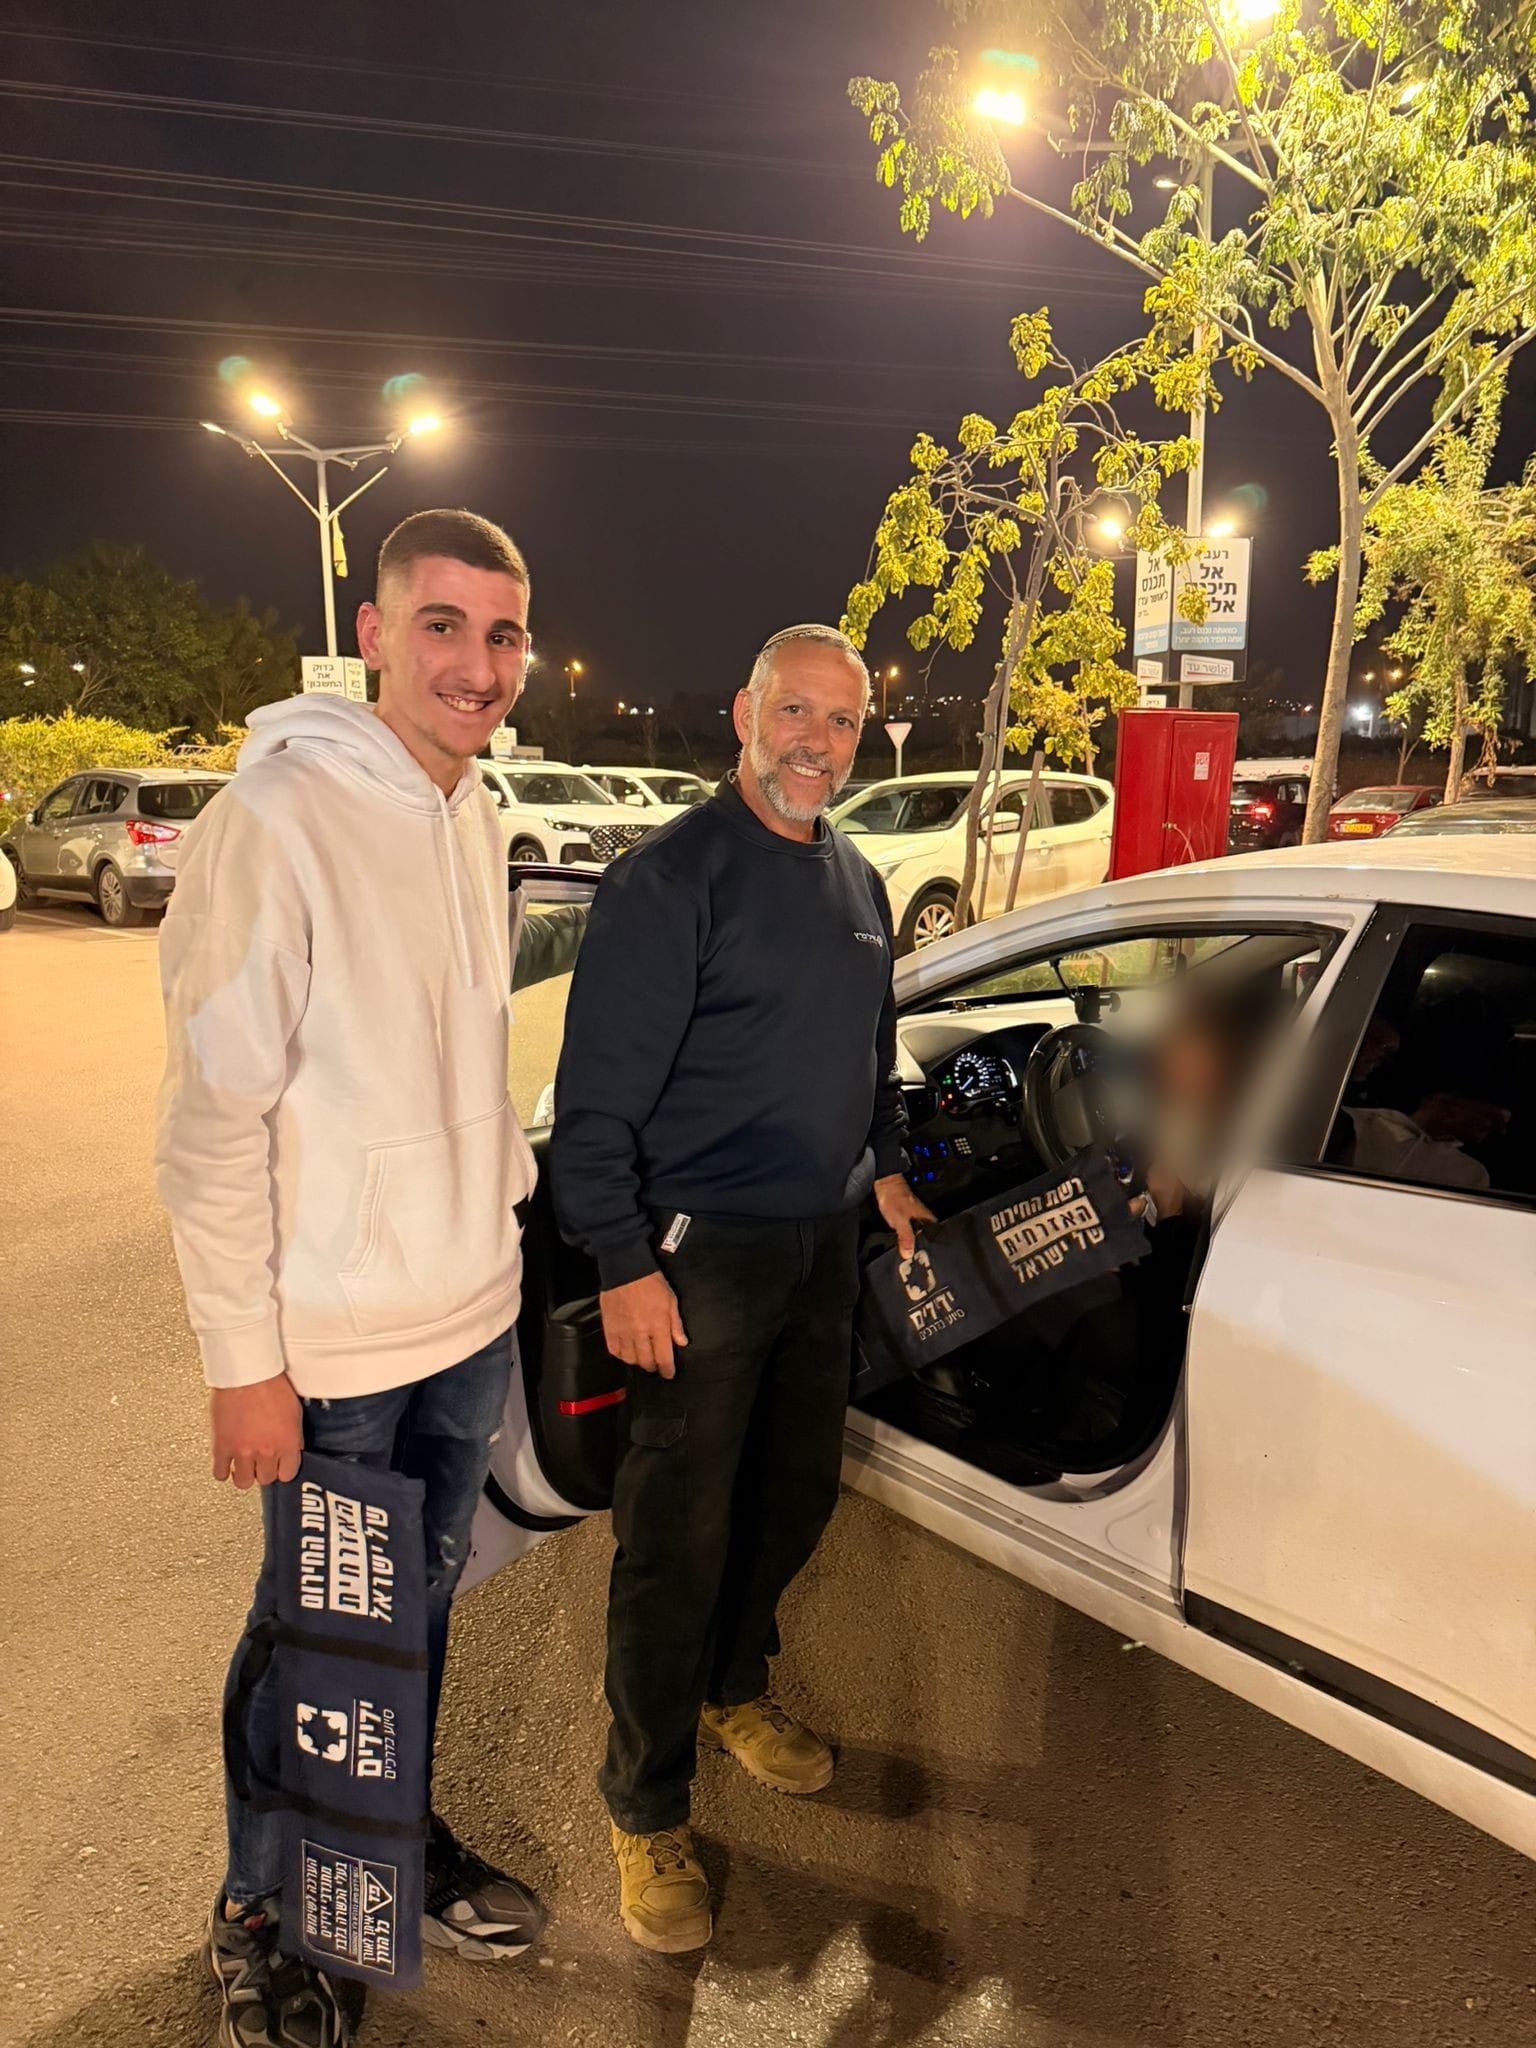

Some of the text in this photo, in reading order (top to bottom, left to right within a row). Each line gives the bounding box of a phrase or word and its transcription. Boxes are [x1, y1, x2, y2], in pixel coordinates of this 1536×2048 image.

[1142, 573, 1165, 592] תכנס
[1148, 556, 1160, 573] אל
[1199, 563, 1224, 579] אל
[313, 664, 334, 672] בדוק
[1186, 663, 1228, 674] אושר עד
[990, 1177, 1085, 1231] רשת החירום
[1002, 1204, 1093, 1256] האזרחית
[1010, 1226, 1105, 1283] של ישראל
[908, 1291, 955, 1330] ידידים
[301, 1481, 325, 1610] רשת החירום
[334, 1500, 360, 1610] האזרחית
[365, 1505, 394, 1623] של ישראל
[357, 1700, 383, 1777] ידידים
[383, 1708, 397, 1779] סיוע בדרכים
[304, 1857, 318, 1935] הערכה לשימוש
[320, 1866, 333, 1938] מתנדבי ידידים
[334, 1861, 347, 1951] בעלי הכשרה בלבד
[362, 1914, 375, 1961] איתך לאורך
[375, 1919, 392, 1964] כל הדרך
